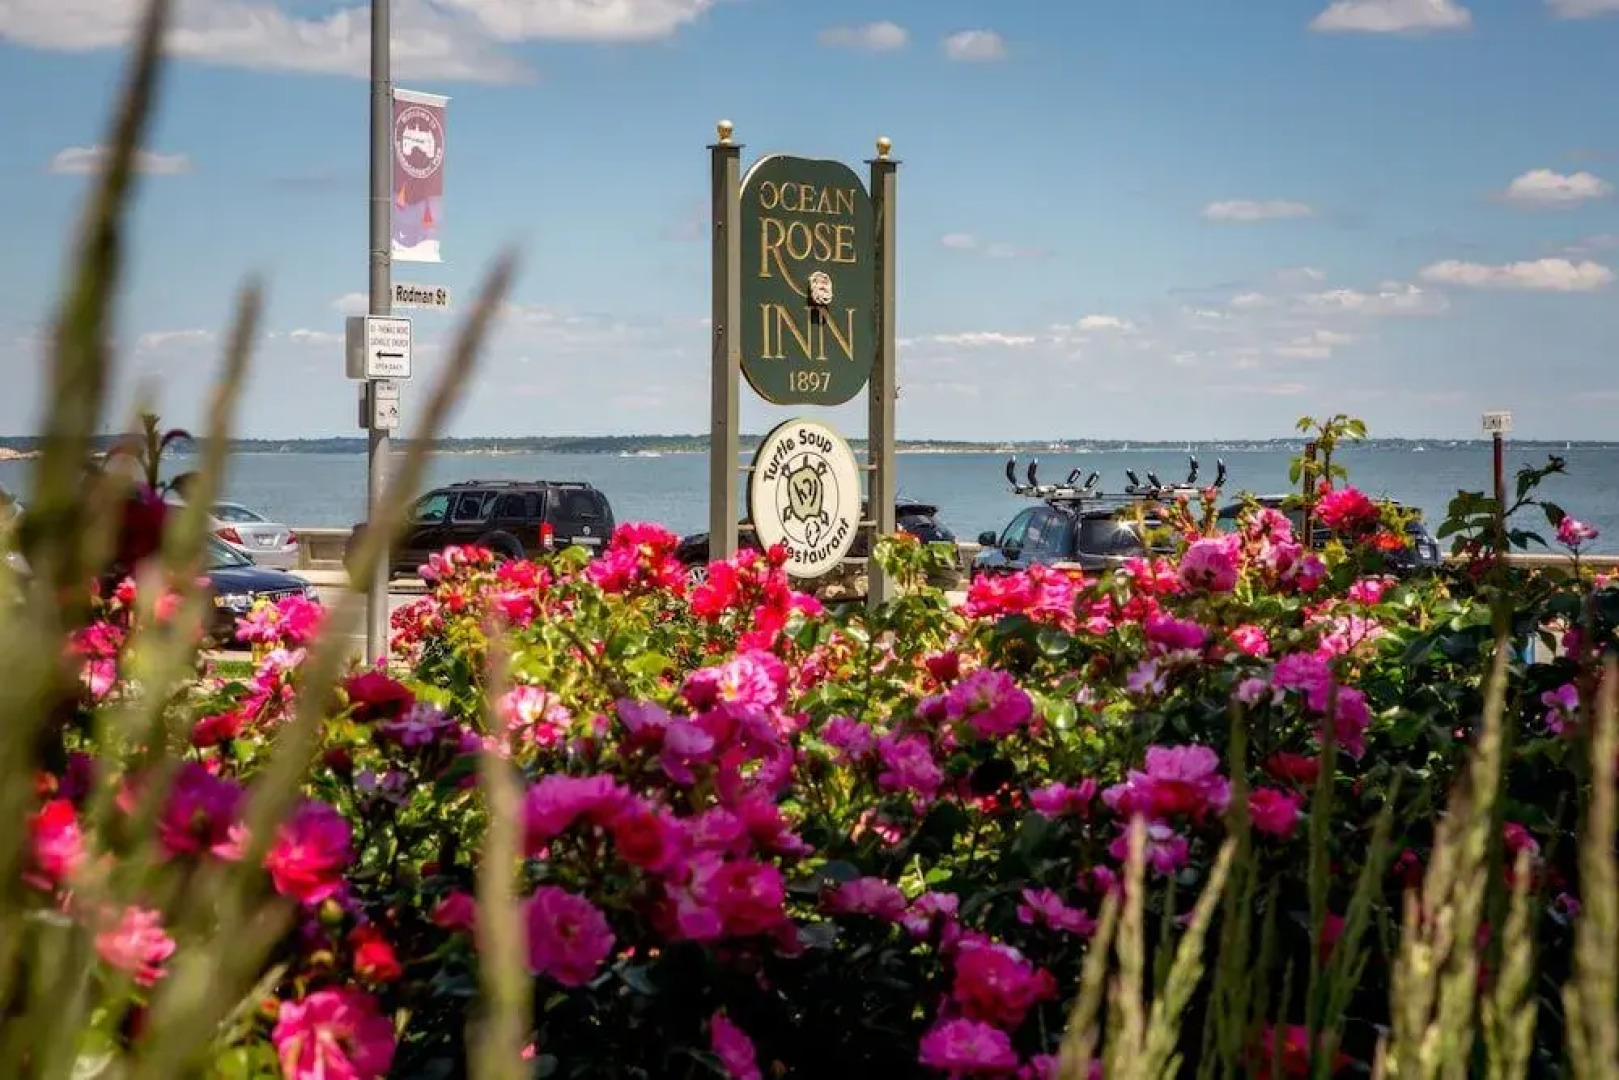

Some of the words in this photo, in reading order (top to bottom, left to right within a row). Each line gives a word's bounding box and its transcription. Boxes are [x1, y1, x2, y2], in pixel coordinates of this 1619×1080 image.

[759, 181, 856, 215] OCEAN
[758, 216, 857, 297] ROSE
[396, 285, 433, 304] Rodman
[436, 288, 446, 306] St
[759, 303, 856, 361] INN
[789, 371, 831, 393] 1897
[763, 437, 796, 482] Turtle
[799, 428, 833, 454] Soup
